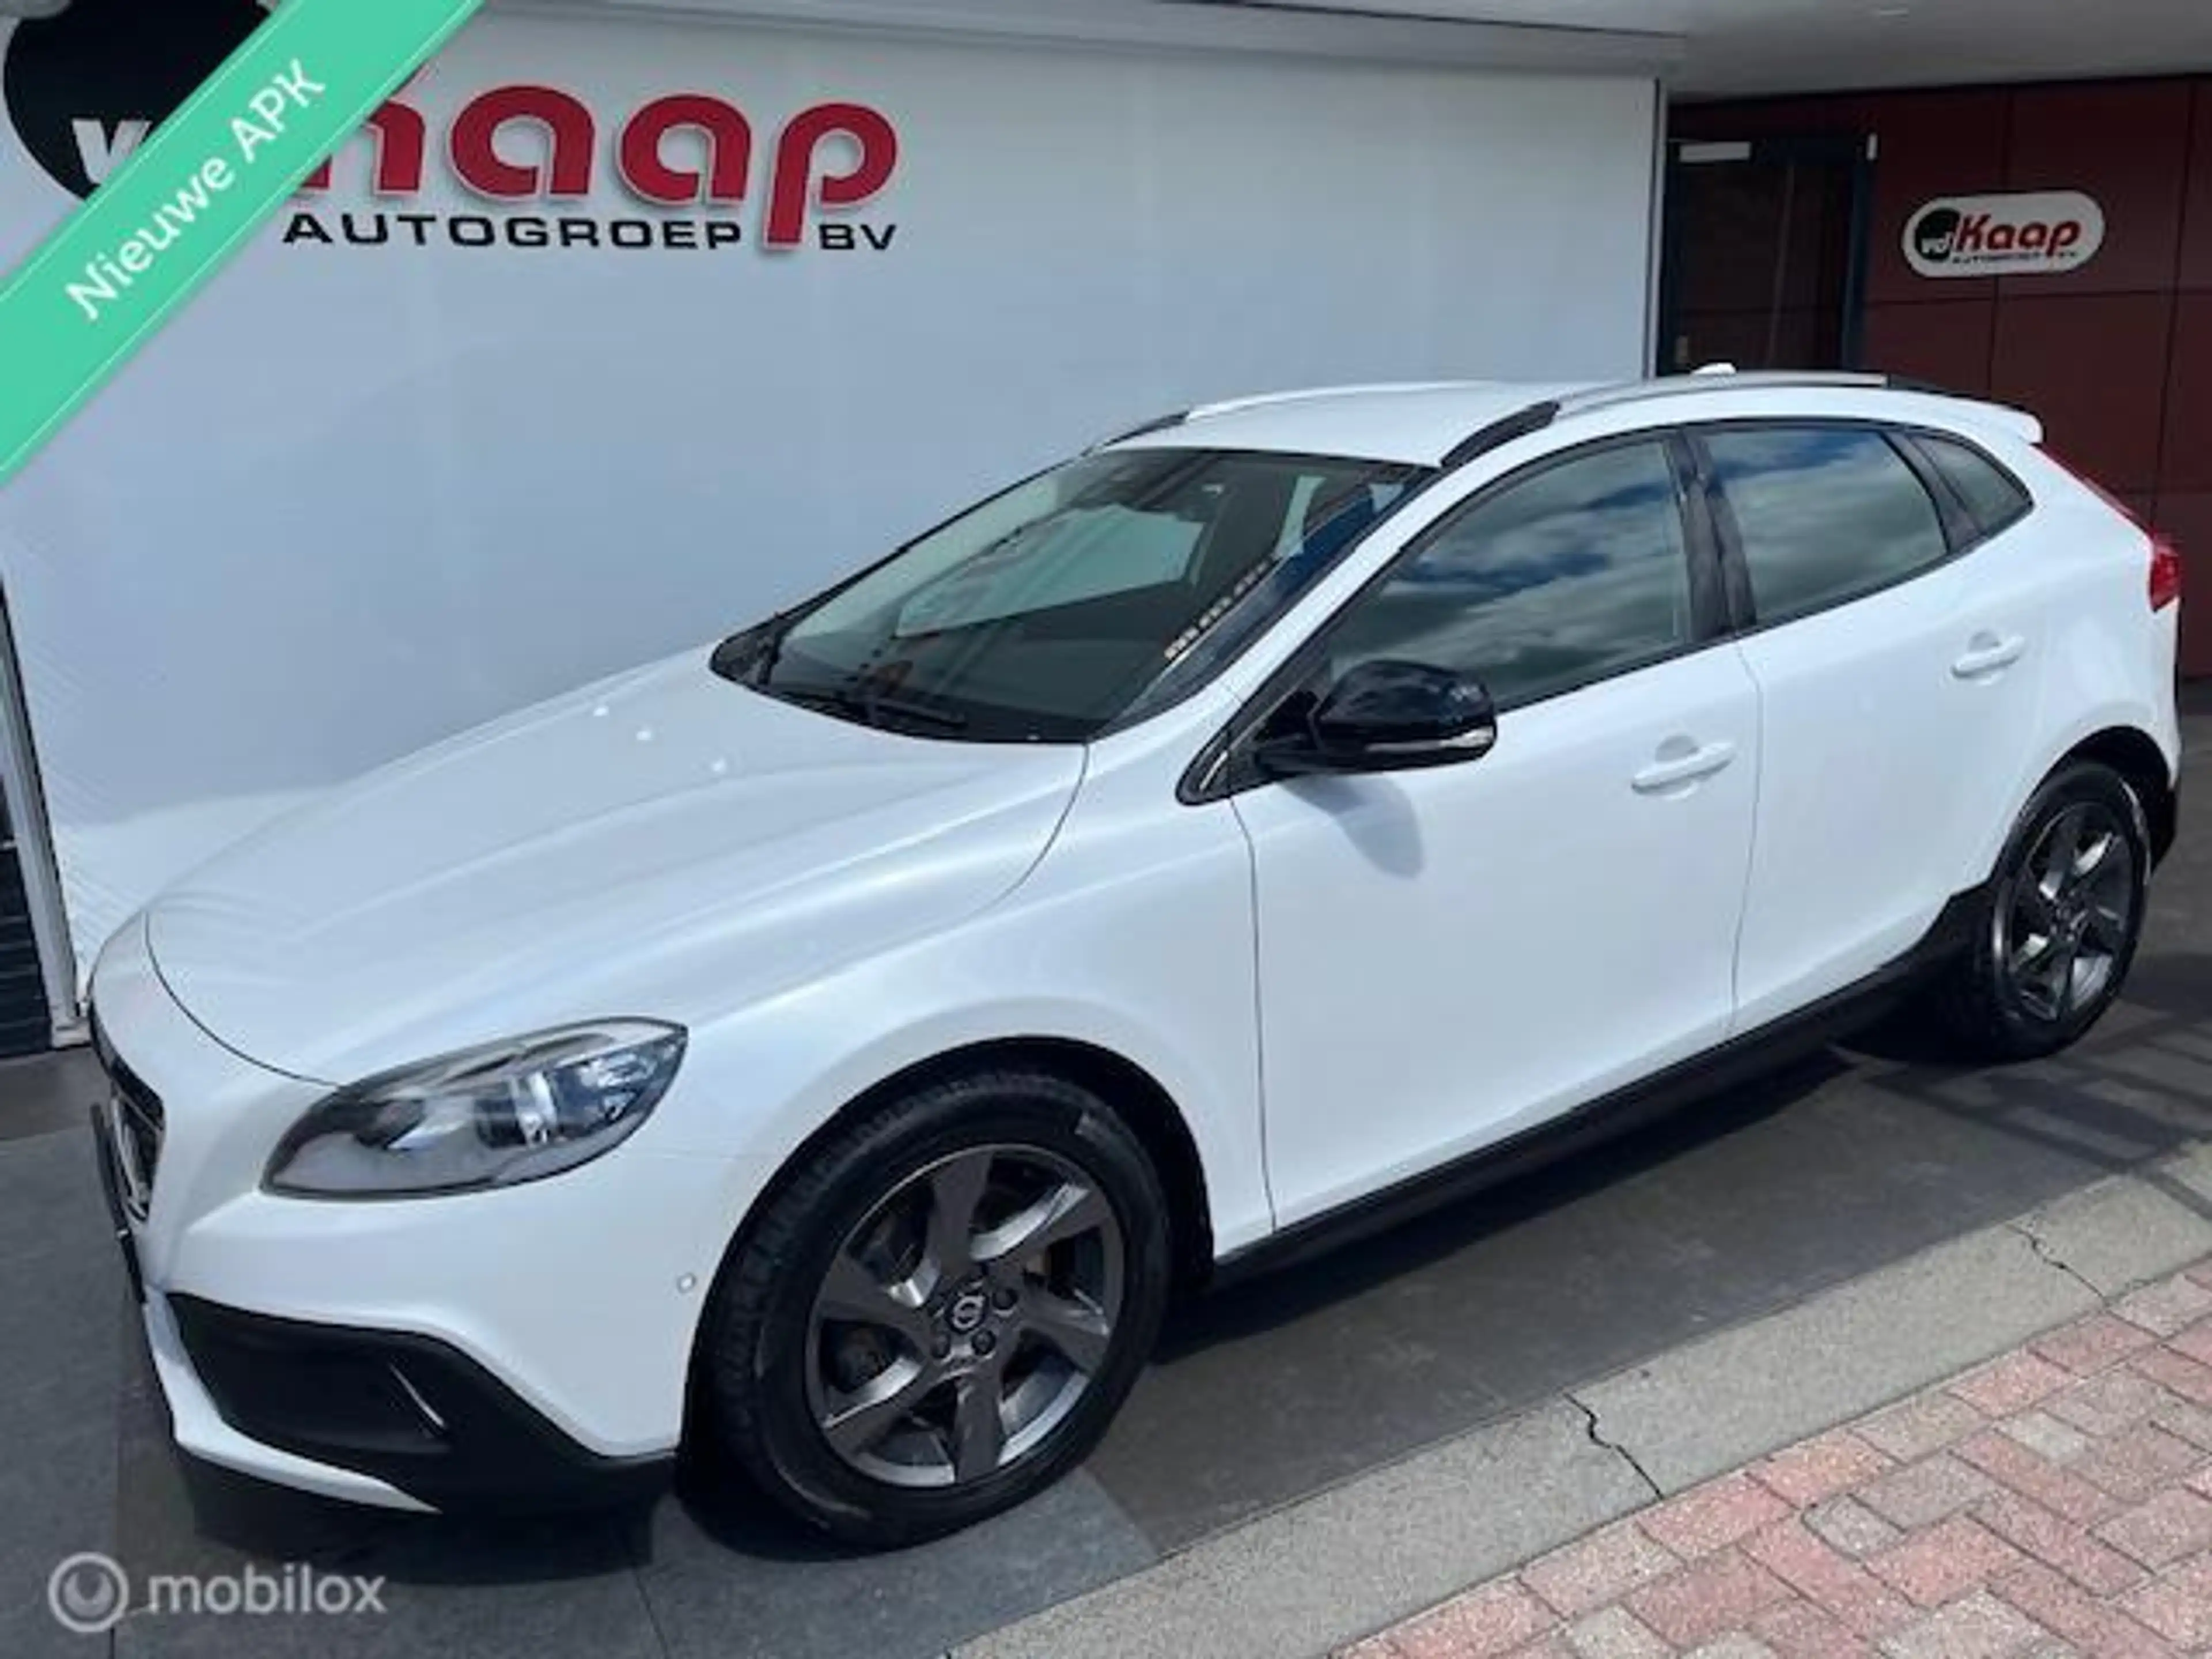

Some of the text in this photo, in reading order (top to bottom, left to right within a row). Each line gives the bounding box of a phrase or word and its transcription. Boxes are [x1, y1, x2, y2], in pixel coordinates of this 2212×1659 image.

[282, 213, 896, 250] AUTOGROEP BV
[1956, 214, 2081, 257] Kaap
